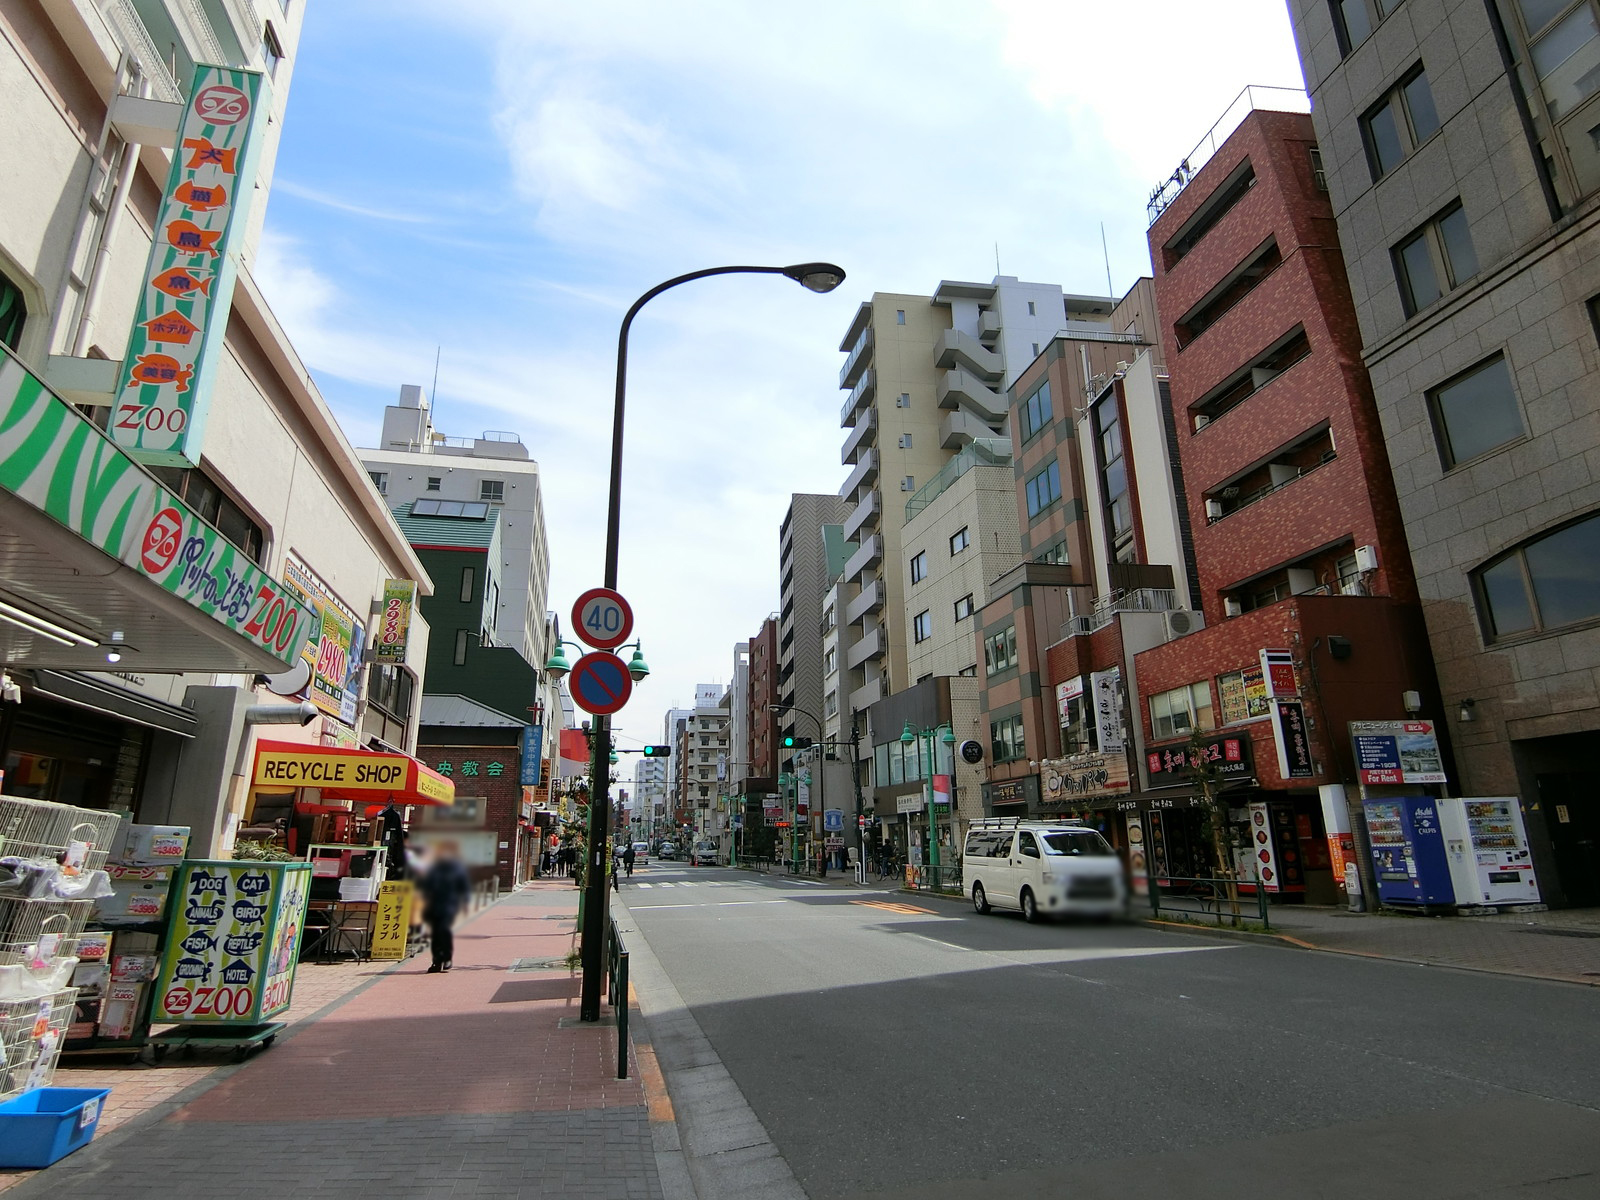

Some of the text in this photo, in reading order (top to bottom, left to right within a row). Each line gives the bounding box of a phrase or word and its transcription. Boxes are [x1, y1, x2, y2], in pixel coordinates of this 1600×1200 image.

[200, 148, 224, 162] 犬
[168, 276, 190, 290] 魚
[152, 322, 190, 336] ホテル
[142, 367, 177, 380] 美容
[115, 404, 186, 432] ZOO
[244, 584, 298, 652] ZOO
[586, 605, 620, 632] 40
[264, 760, 402, 784] RECYCLE SHOP
[200, 878, 264, 890] DOG CAT
[190, 906, 260, 919] ANIMALS BIRD
[186, 938, 254, 950] FISH REPTILE
[178, 963, 248, 981] GROOMING HOTEL
[191, 987, 253, 1016] ZOO
[270, 978, 290, 1010] ZOO
